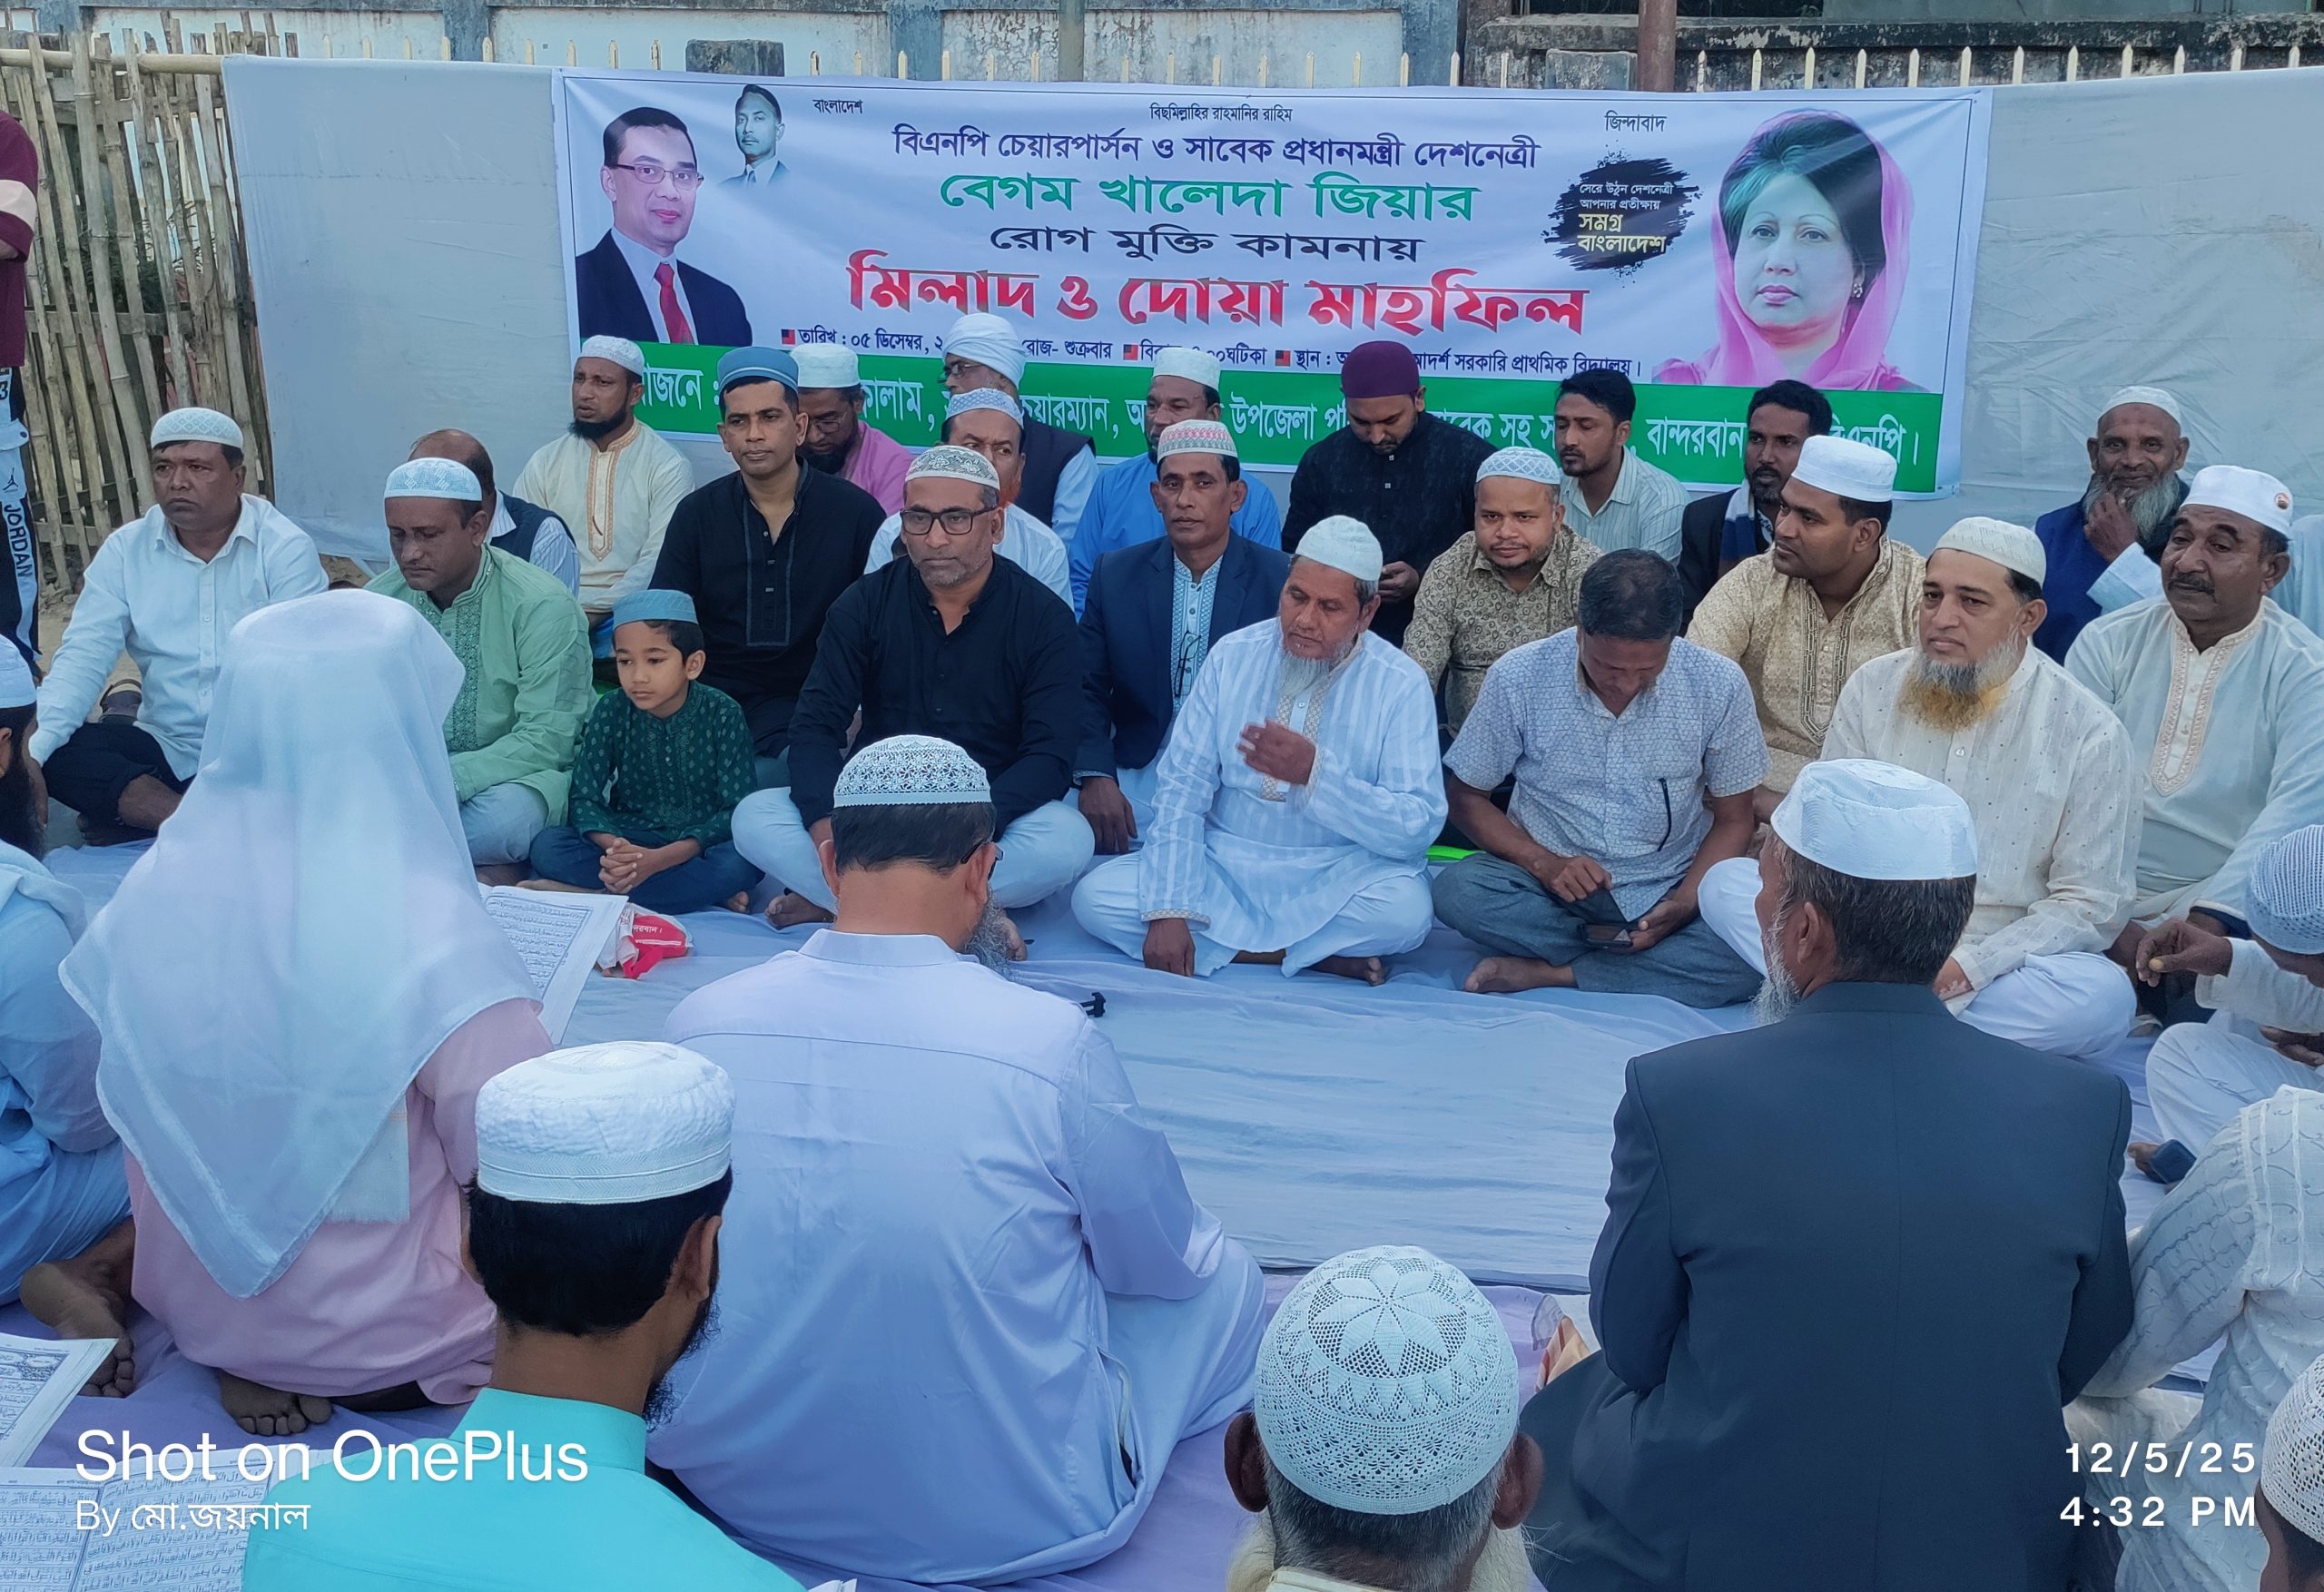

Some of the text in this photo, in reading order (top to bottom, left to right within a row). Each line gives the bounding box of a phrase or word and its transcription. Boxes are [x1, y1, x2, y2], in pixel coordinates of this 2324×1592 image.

[813, 98, 863, 115] বাংলাদেশ
[1150, 103, 1293, 123] বিছমিল্লাহির রাহমানির রাহিম
[1604, 110, 1668, 133] জিন্দাবাদ
[891, 123, 1541, 170] বিএনপি চেয়ারপার্সন ও সাবেক প্রধানমন্ত্রী দেশনেত্রী
[940, 171, 1483, 222] বেগম খালেদা জিয়ার
[1579, 180, 1675, 197] সেরে উঠুন দেশনেত্রী
[1579, 197, 1660, 211] আপনার প্রতীক্ষায়
[1578, 212, 1623, 233] সমগ্র
[990, 223, 1428, 263] রোগ মুক্তি কামনায়
[1577, 234, 1667, 253] বাংলাদেশ
[845, 249, 1590, 337] মিলাদ ও দোয়া মাহফিল
[851, 333, 871, 349] ০৫
[1064, 339, 1113, 359] শুক্রবার
[1294, 349, 1321, 371] স্থান
[1453, 349, 1509, 372] সরকারি
[1511, 350, 1570, 374] প্রাথমিক
[1228, 391, 1317, 440] উপজেলা
[1498, 413, 1534, 447] সহ
[3, 503, 34, 578] JORDAN
